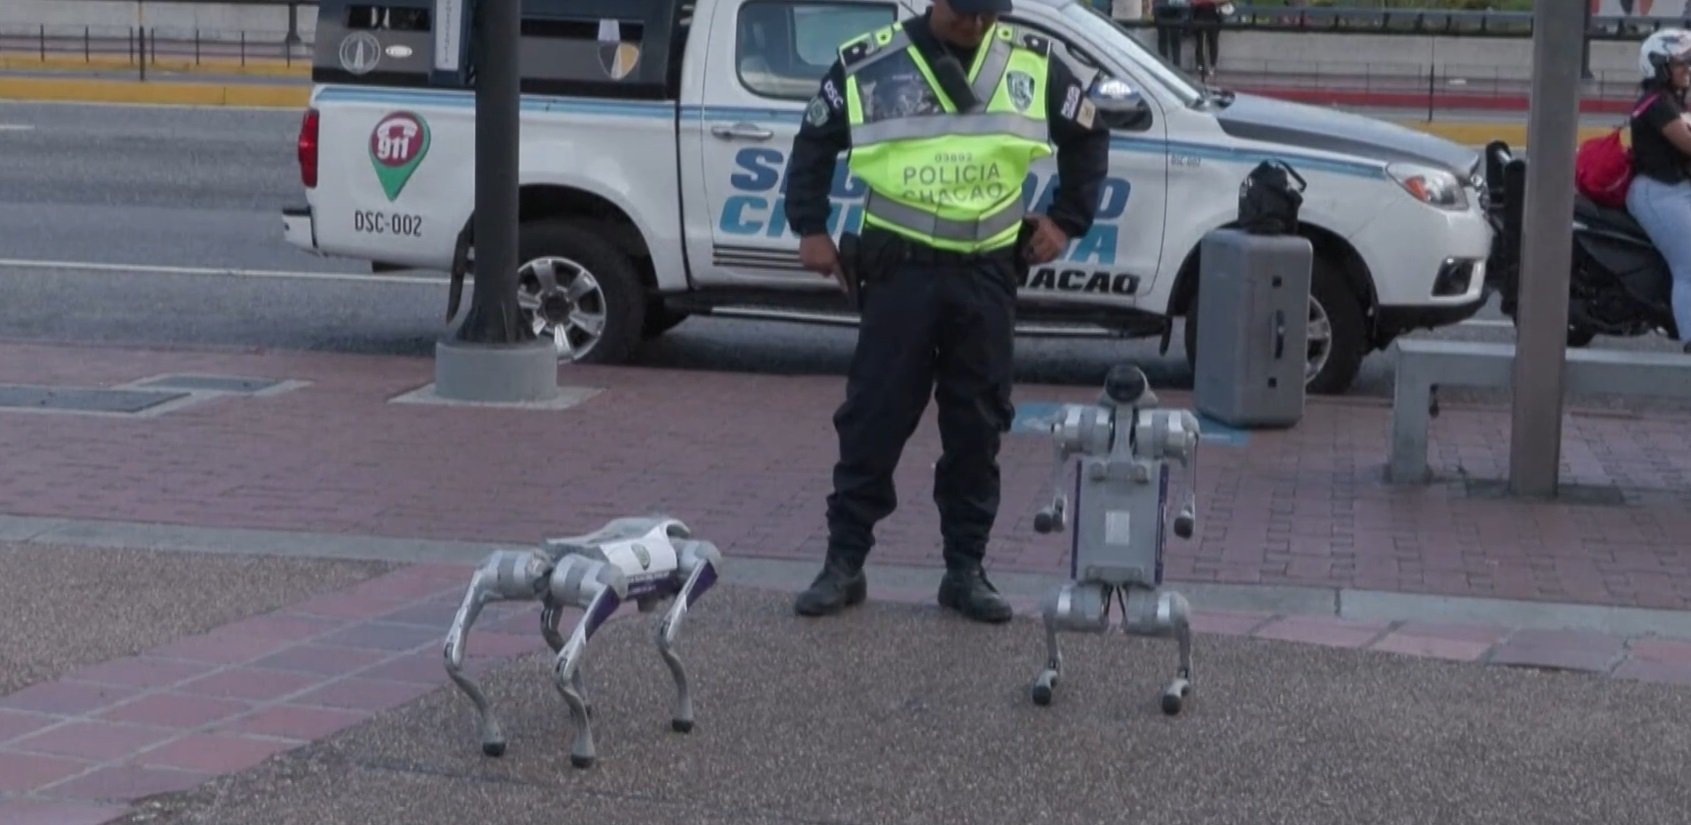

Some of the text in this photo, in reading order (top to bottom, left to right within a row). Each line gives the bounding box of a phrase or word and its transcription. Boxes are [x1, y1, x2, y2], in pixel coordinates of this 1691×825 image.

[377, 136, 409, 159] 911
[903, 161, 1000, 186] POLICIA
[354, 209, 422, 238] DSC-002
[1018, 267, 1141, 295] ACAO
